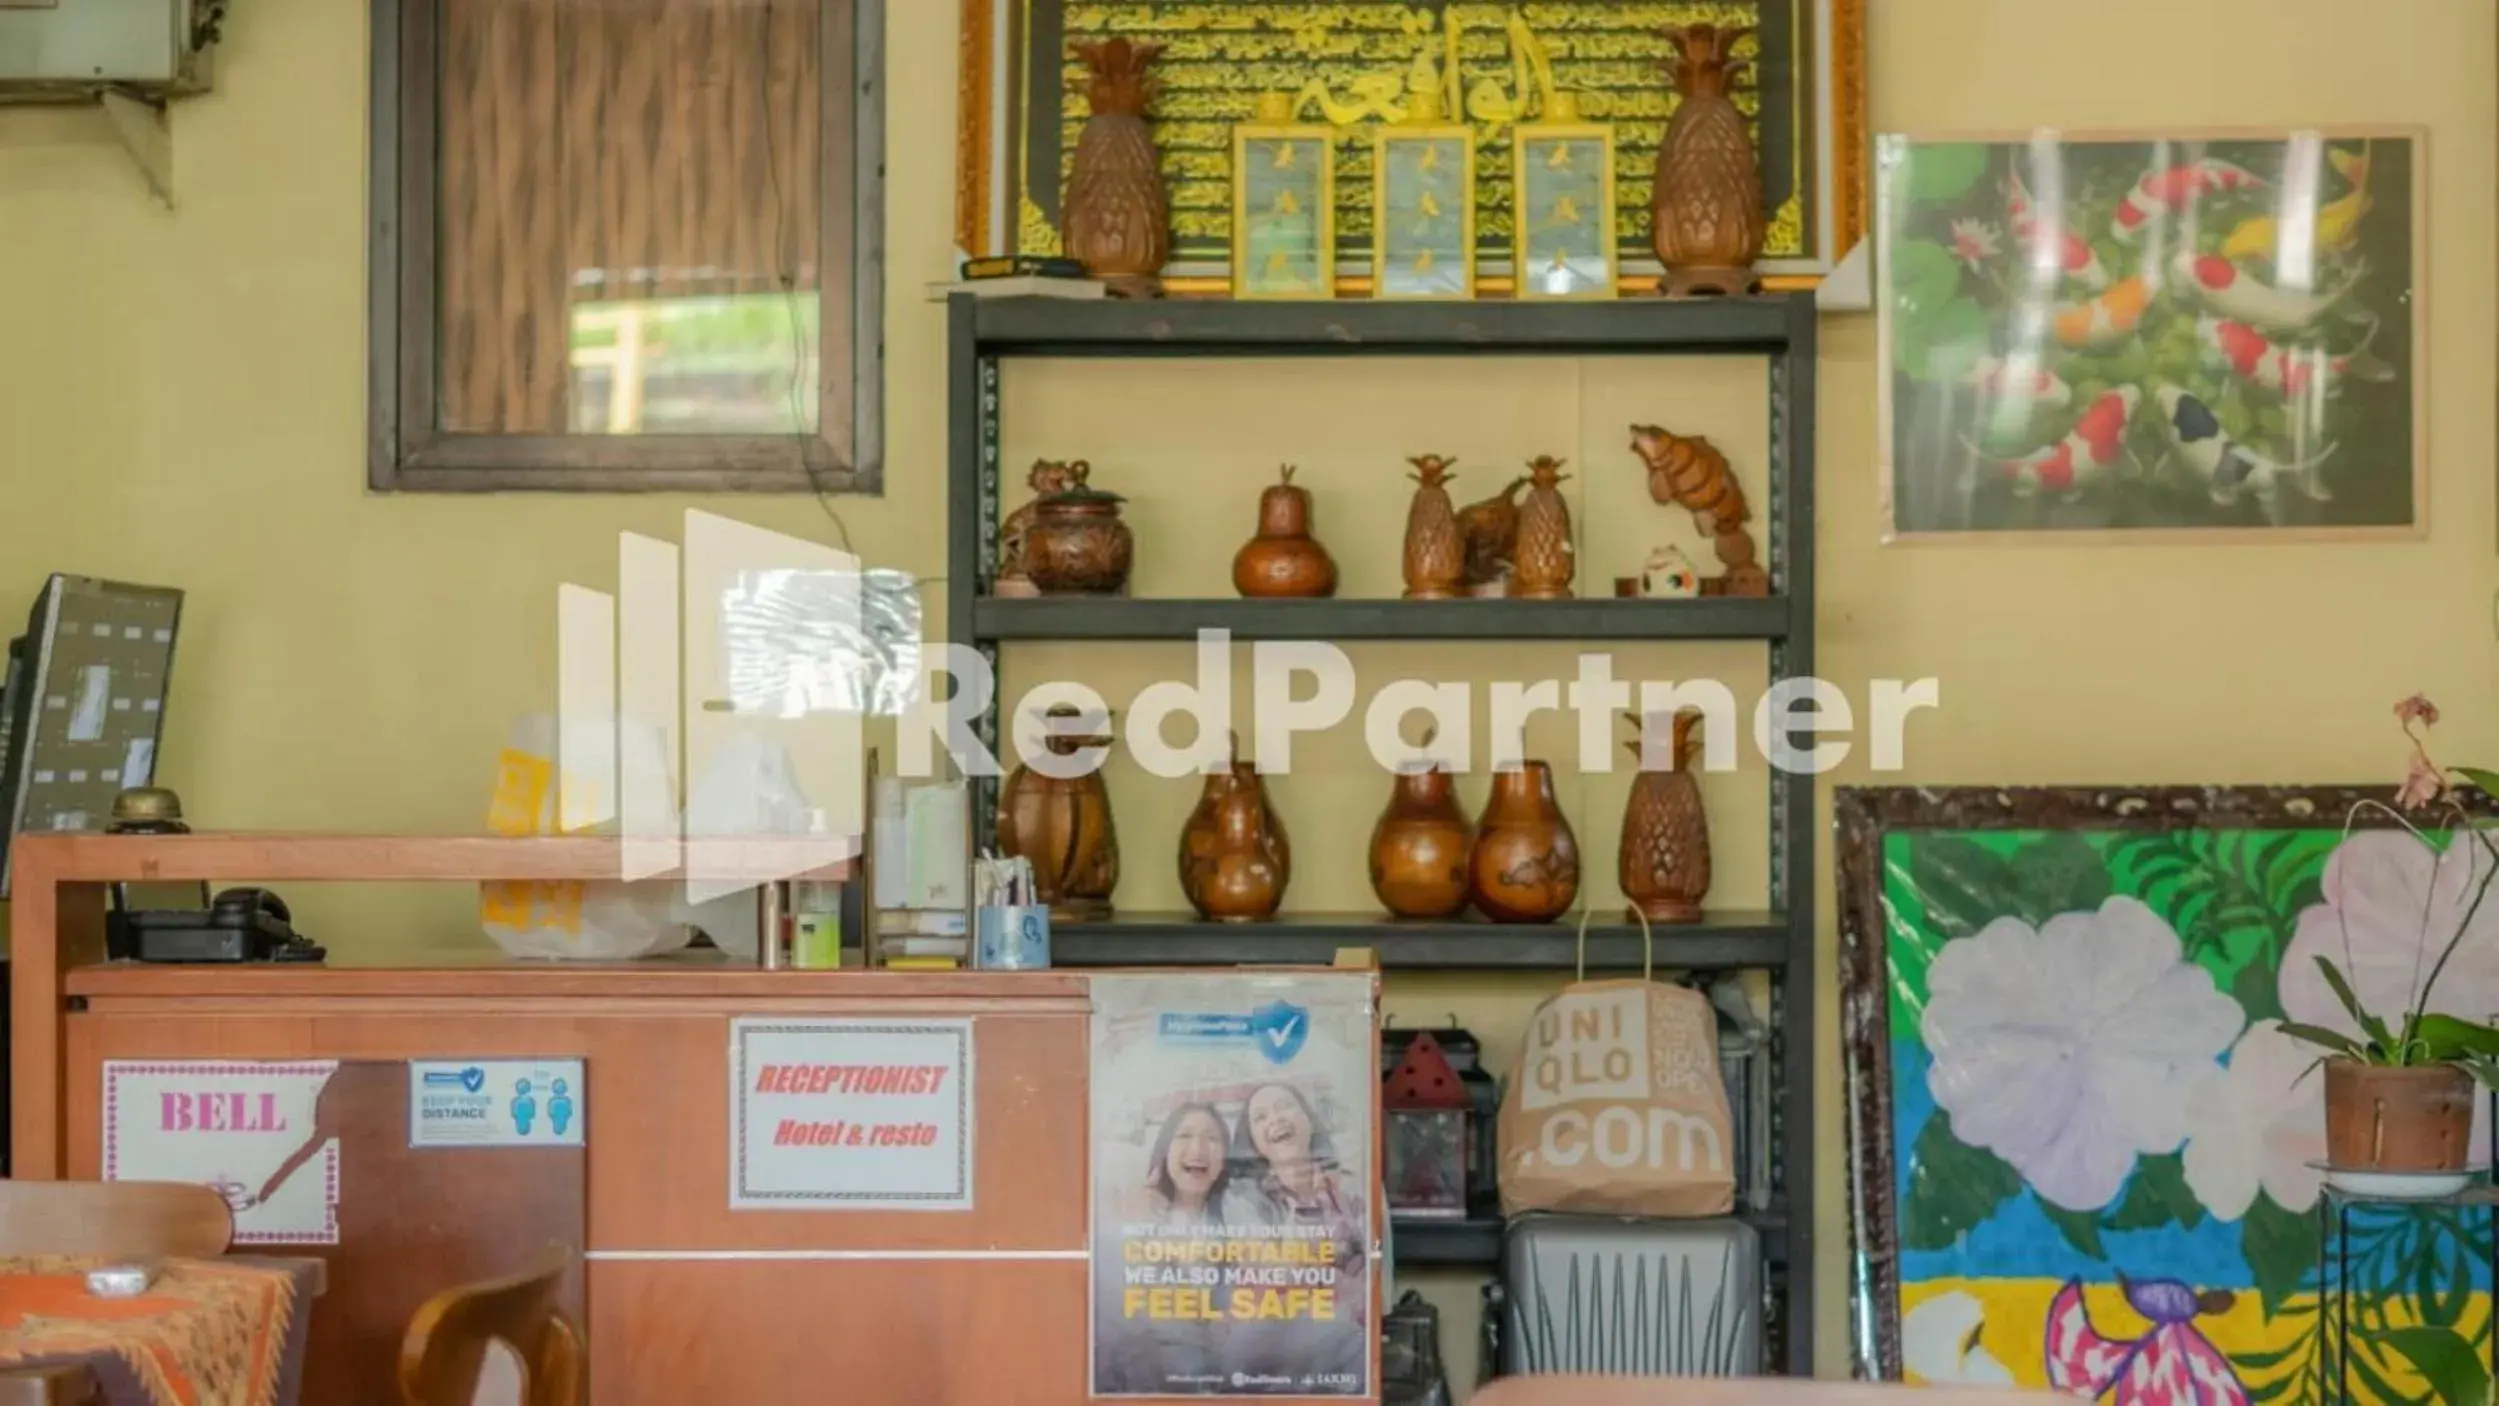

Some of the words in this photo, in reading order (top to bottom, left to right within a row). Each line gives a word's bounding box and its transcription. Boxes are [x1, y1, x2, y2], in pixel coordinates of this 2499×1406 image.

[1538, 1003, 1623, 1048] UNI
[755, 1063, 949, 1095] RECEPTIONIST
[1535, 1048, 1633, 1094] QLO
[160, 1092, 287, 1131] BELL
[422, 1108, 486, 1119] DISTANCE
[773, 1118, 844, 1146] Hotel
[845, 1122, 863, 1146] &
[867, 1121, 939, 1147] resto
[1520, 1104, 1724, 1172] .com
[1123, 1239, 1335, 1263] COMFORTABLE
[1125, 1266, 1157, 1284] WE
[1161, 1266, 1220, 1285] ALSO
[1223, 1266, 1287, 1285] MAKE
[1291, 1266, 1336, 1285] YOU
[1123, 1287, 1224, 1319] FEEL
[1230, 1287, 1336, 1319] SAFE
